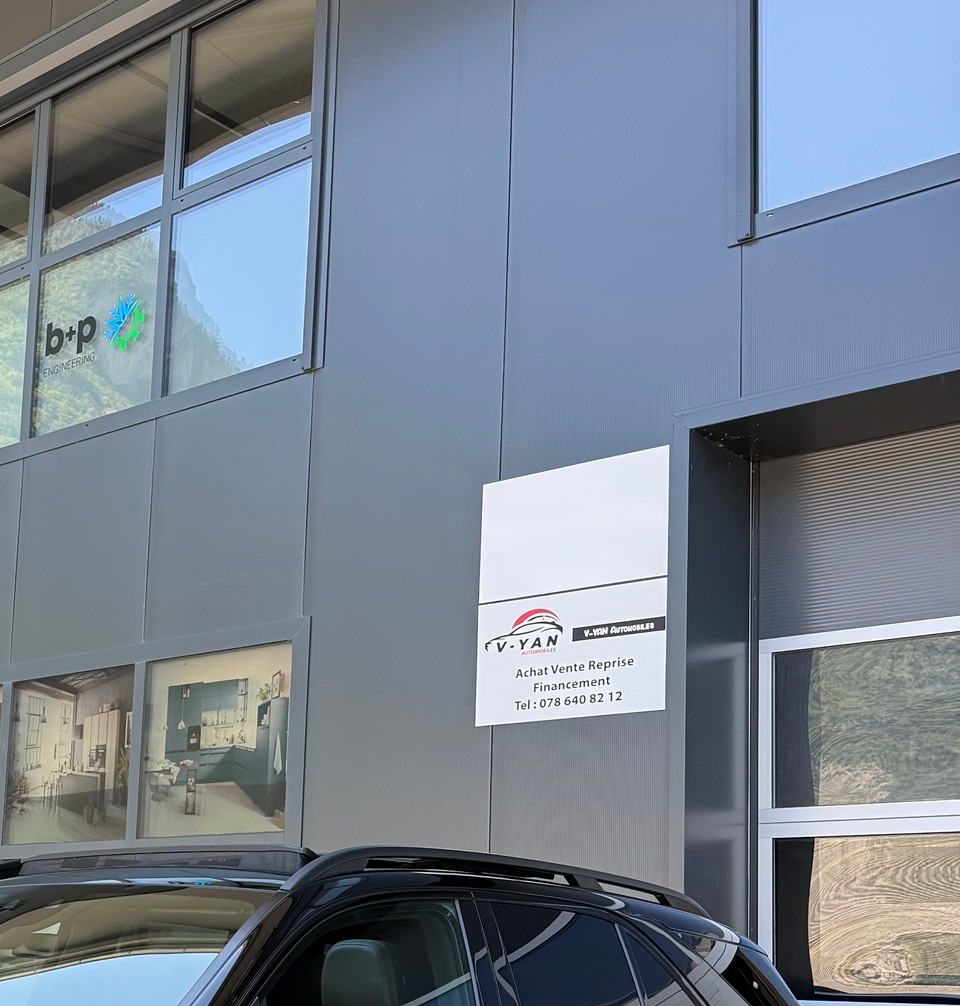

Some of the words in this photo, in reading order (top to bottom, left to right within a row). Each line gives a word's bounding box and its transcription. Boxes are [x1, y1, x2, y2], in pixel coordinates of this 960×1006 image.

[45, 316, 97, 357] b+p
[43, 352, 96, 378] ENGINEERING
[584, 627, 609, 638] V-YAN
[521, 647, 556, 656] AUTOMOBILES
[515, 664, 549, 679] Achat
[551, 661, 585, 675] Vente
[589, 657, 635, 672] Reprise
[533, 676, 611, 693] Financement
[539, 697, 561, 709] 078
[564, 694, 587, 706] 640
[589, 692, 604, 704] 82
[609, 691, 623, 702] 12
